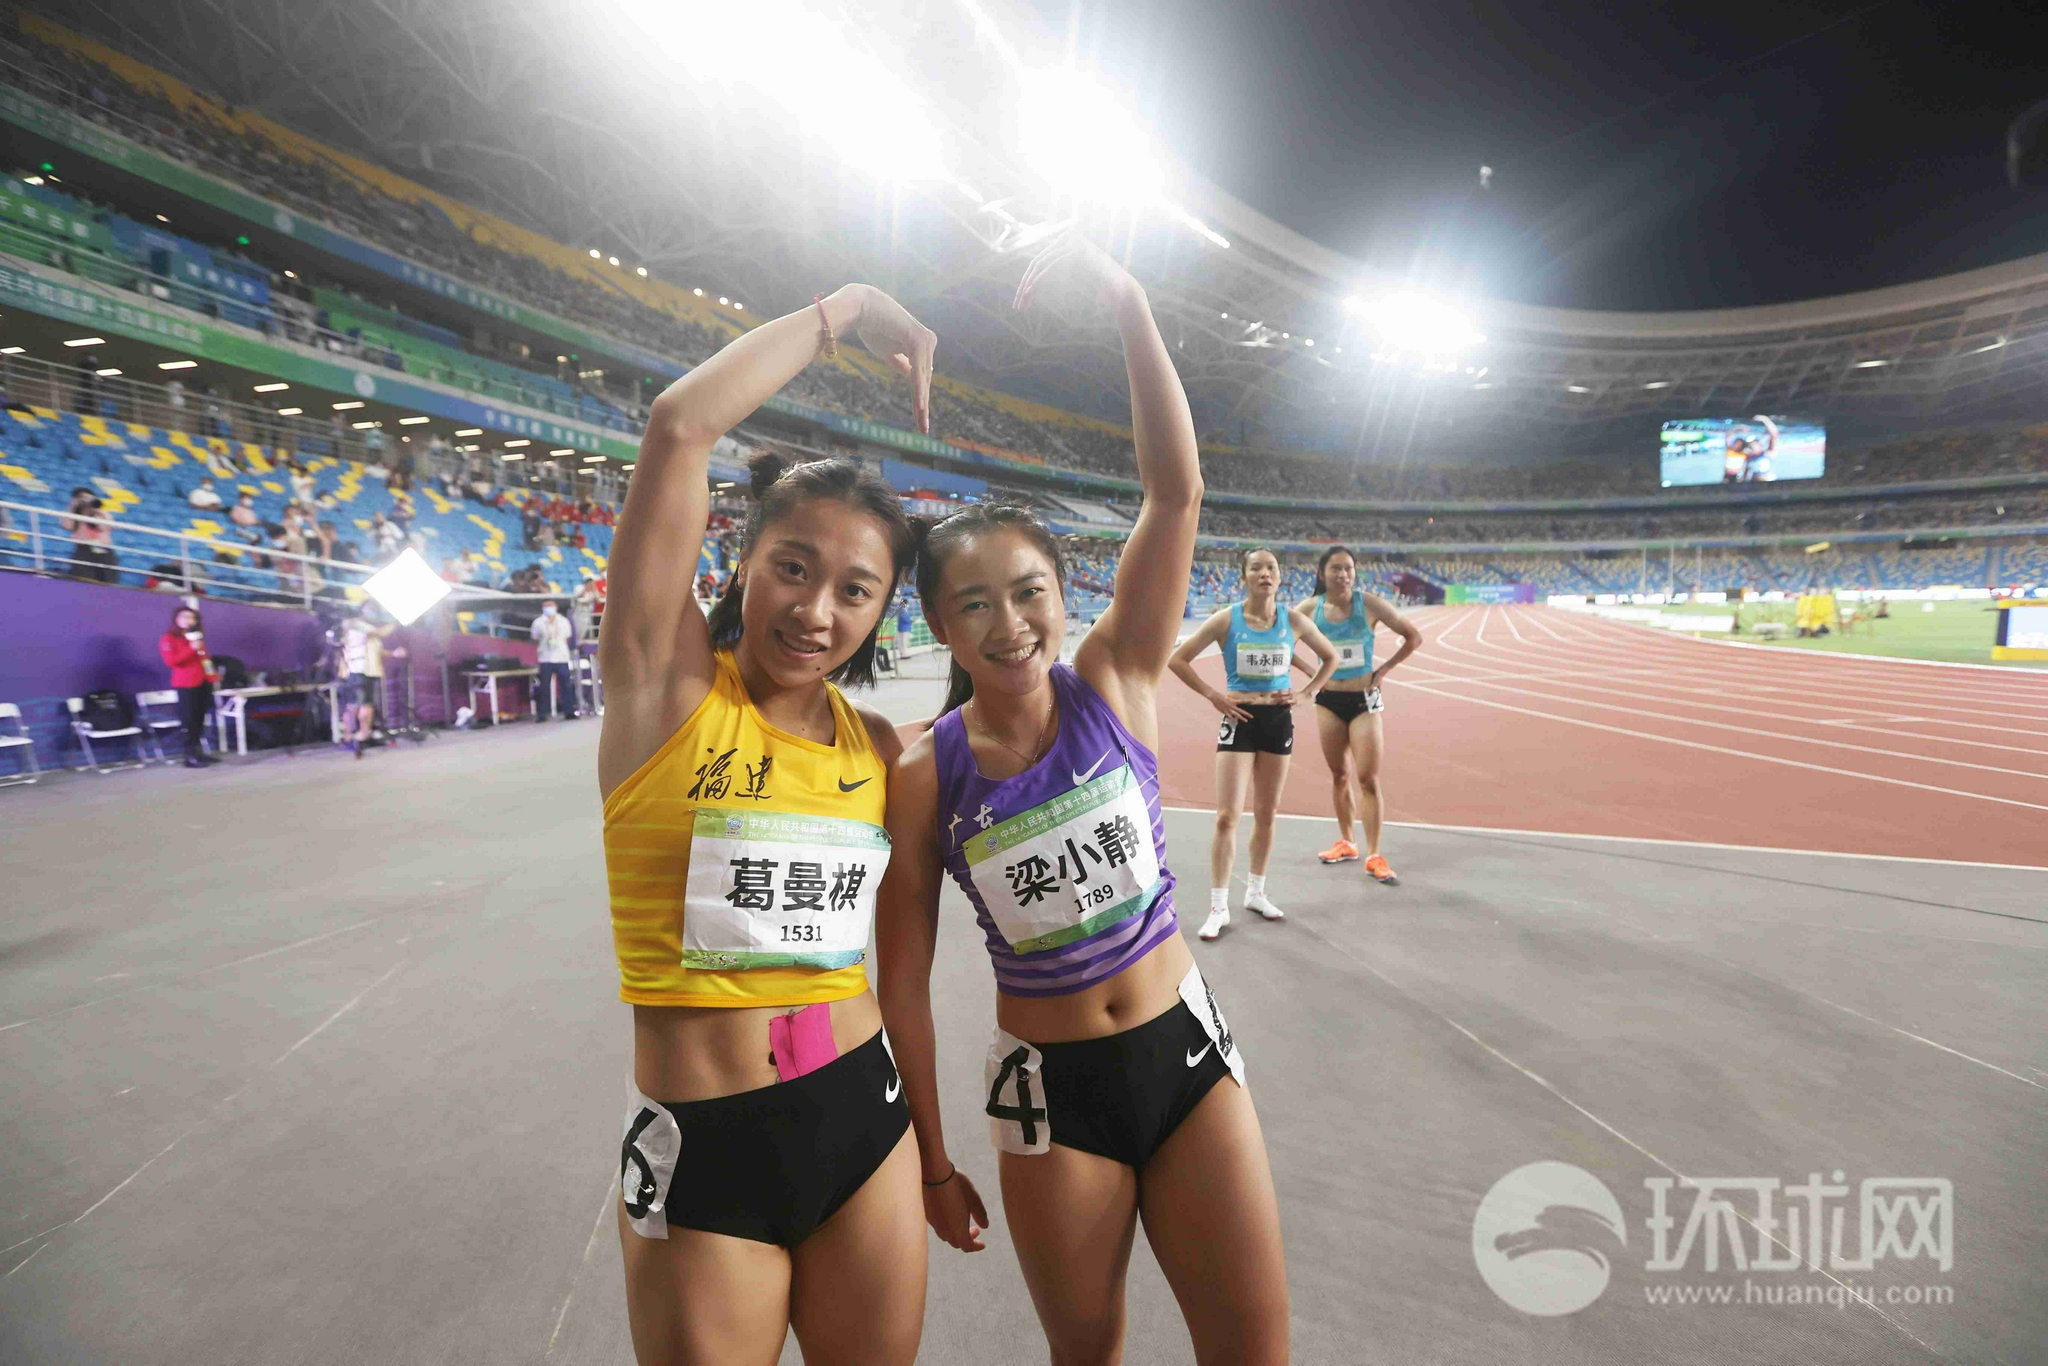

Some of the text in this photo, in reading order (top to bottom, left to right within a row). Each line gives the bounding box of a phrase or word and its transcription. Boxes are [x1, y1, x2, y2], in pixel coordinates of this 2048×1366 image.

[1246, 653, 1284, 667] 韦永丽
[688, 748, 773, 801] 福建
[748, 818, 875, 839] 中华人民共和国第十四届运动会
[948, 804, 994, 850] 广东
[1000, 776, 1122, 839] 中华人民共和国第十四届运动会
[725, 858, 866, 911] 葛曼棋
[1005, 814, 1139, 907] 梁小静
[1074, 884, 1114, 914] 1789
[780, 925, 823, 941] 1531
[985, 1045, 1046, 1145] 4
[621, 1106, 659, 1220] 6
